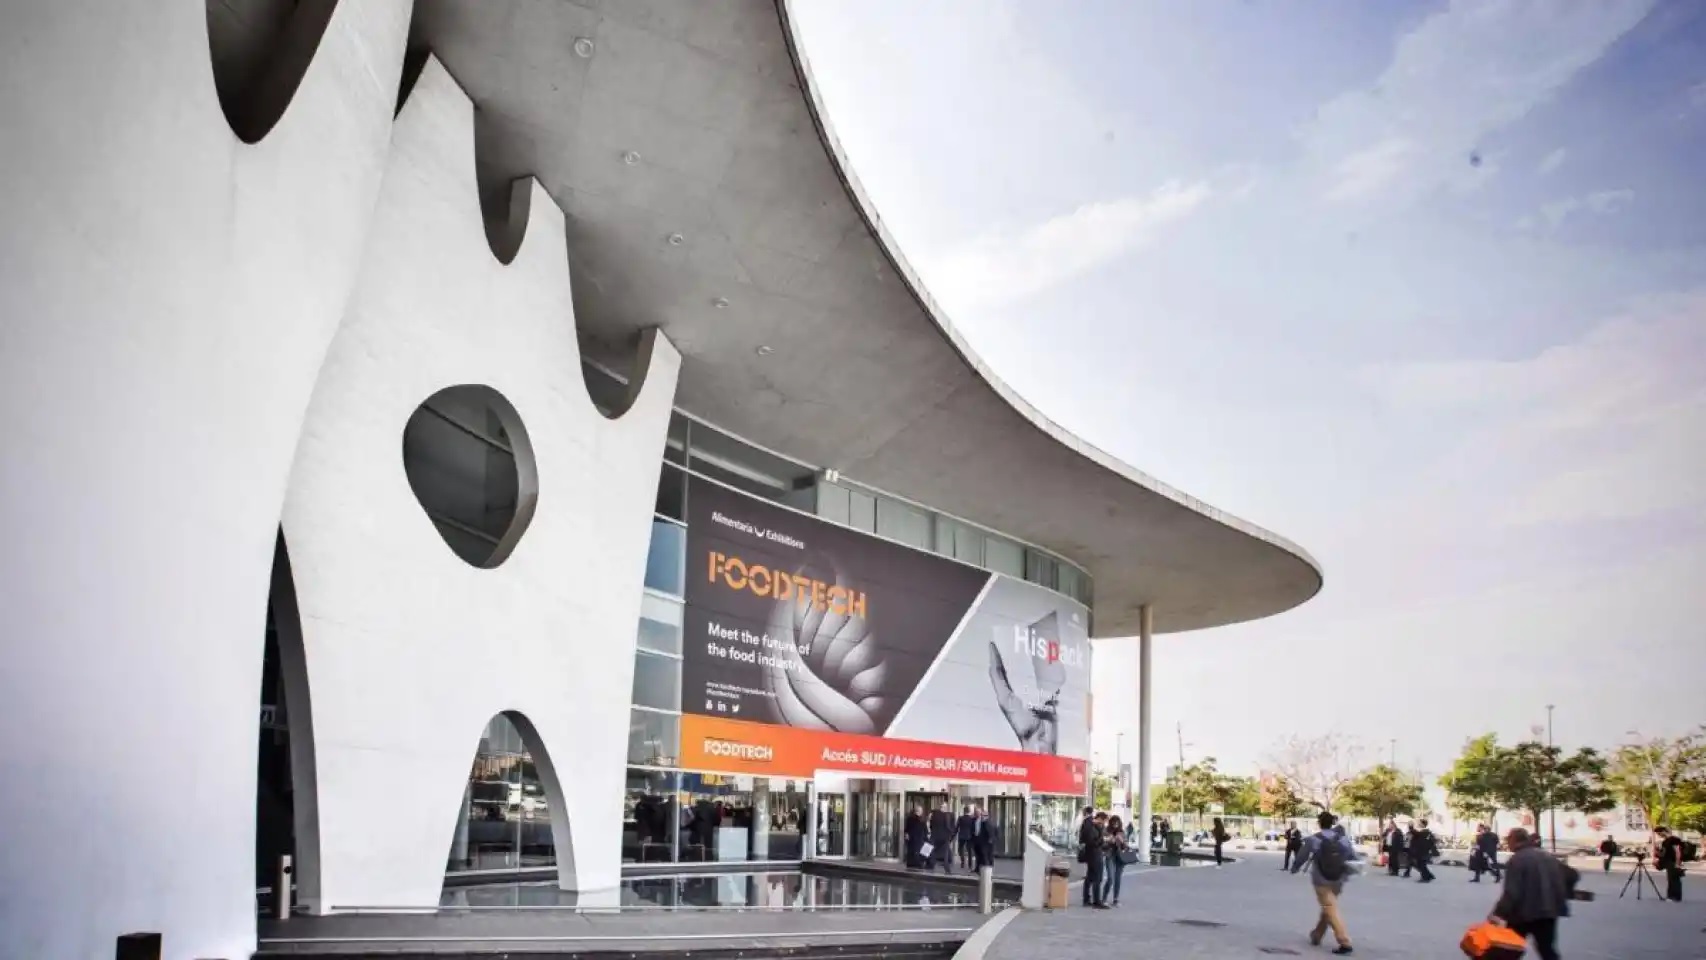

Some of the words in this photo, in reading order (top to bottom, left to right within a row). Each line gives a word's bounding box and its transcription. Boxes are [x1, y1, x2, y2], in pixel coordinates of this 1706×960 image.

[712, 511, 753, 534] Alimentaria
[766, 530, 805, 549] Exhibitions
[708, 551, 866, 620] FOODTECH
[708, 622, 739, 641] Meet
[741, 630, 760, 645] the
[762, 633, 796, 653] future
[799, 643, 811, 656] of
[708, 642, 726, 658] the
[729, 646, 755, 663] food
[1014, 624, 1084, 669] Hispack
[704, 739, 773, 760] FOODTECH
[861, 751, 887, 766] SUD
[934, 758, 956, 771] SUR
[962, 760, 995, 773] SOUTH
